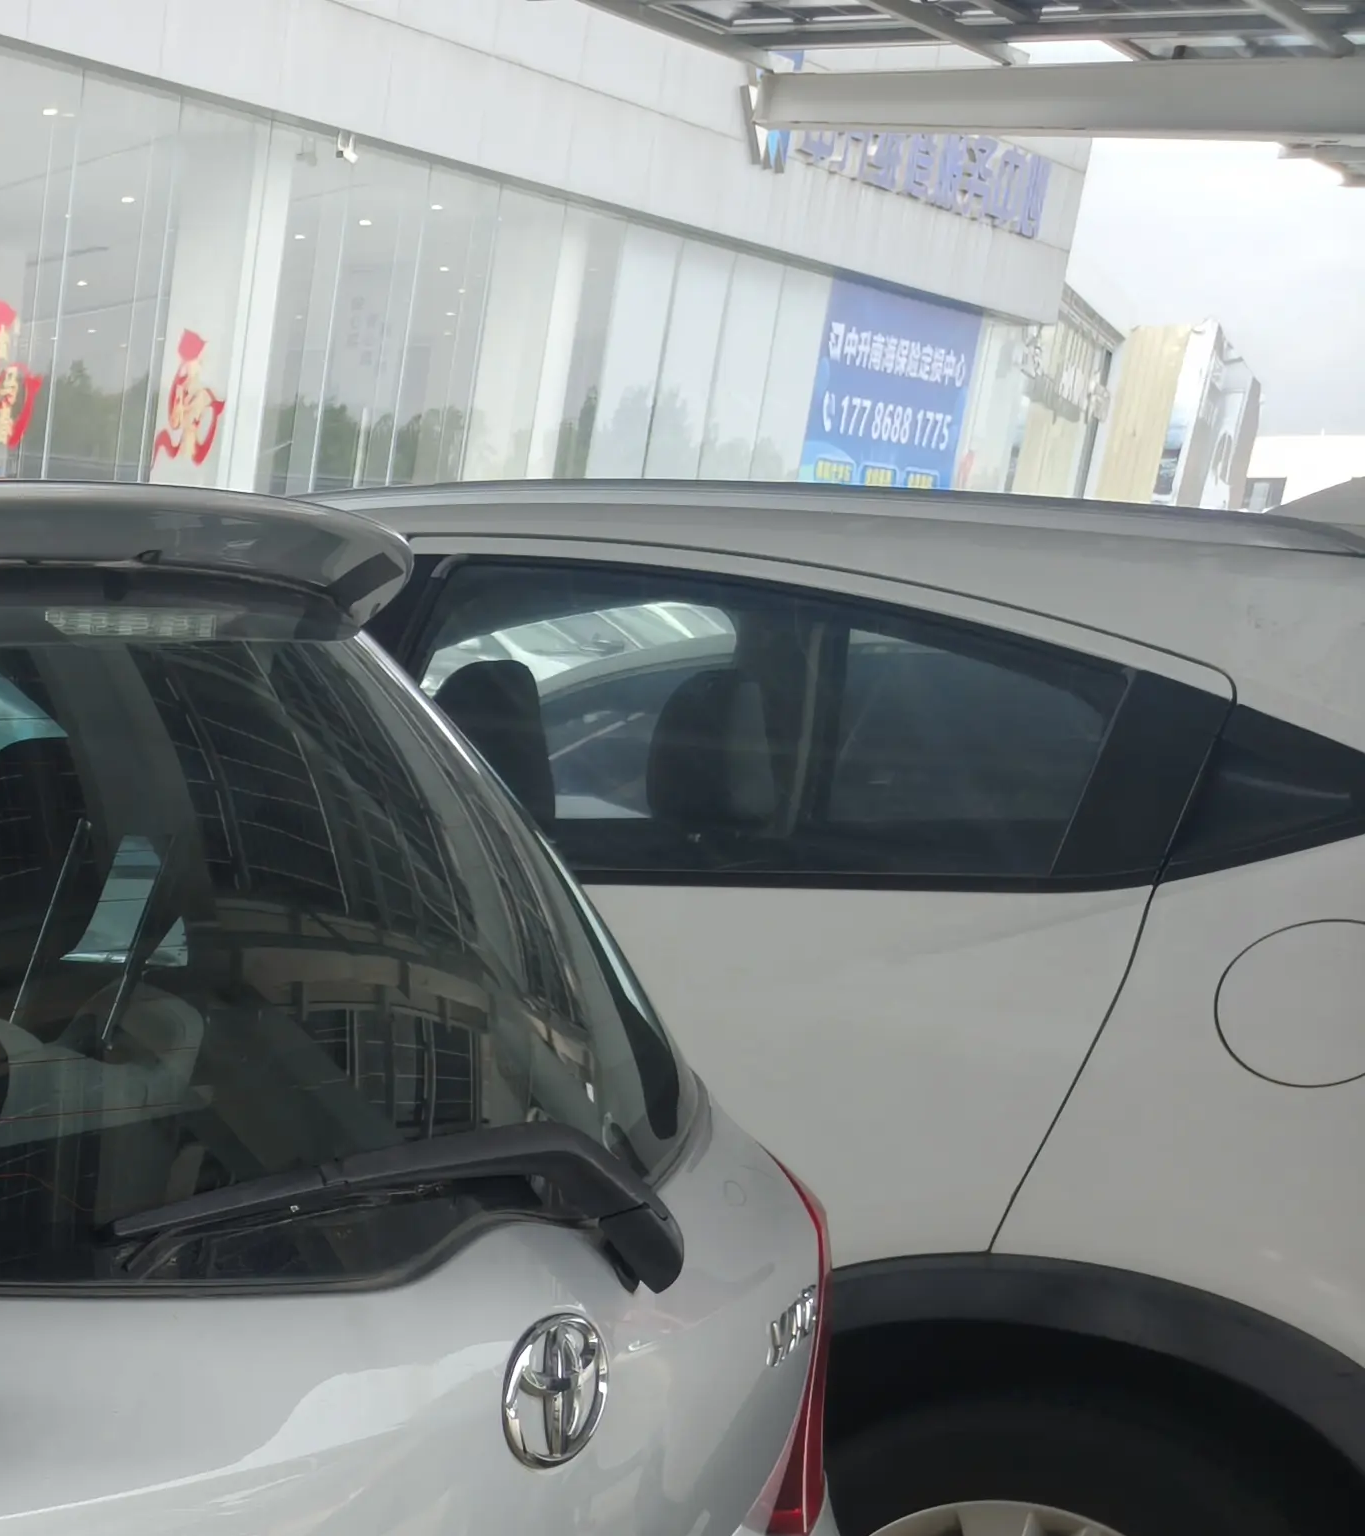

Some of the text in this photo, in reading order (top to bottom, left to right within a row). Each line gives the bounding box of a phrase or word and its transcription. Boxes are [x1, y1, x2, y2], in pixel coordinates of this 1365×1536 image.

[839, 395, 952, 451] 177 8688 1775
